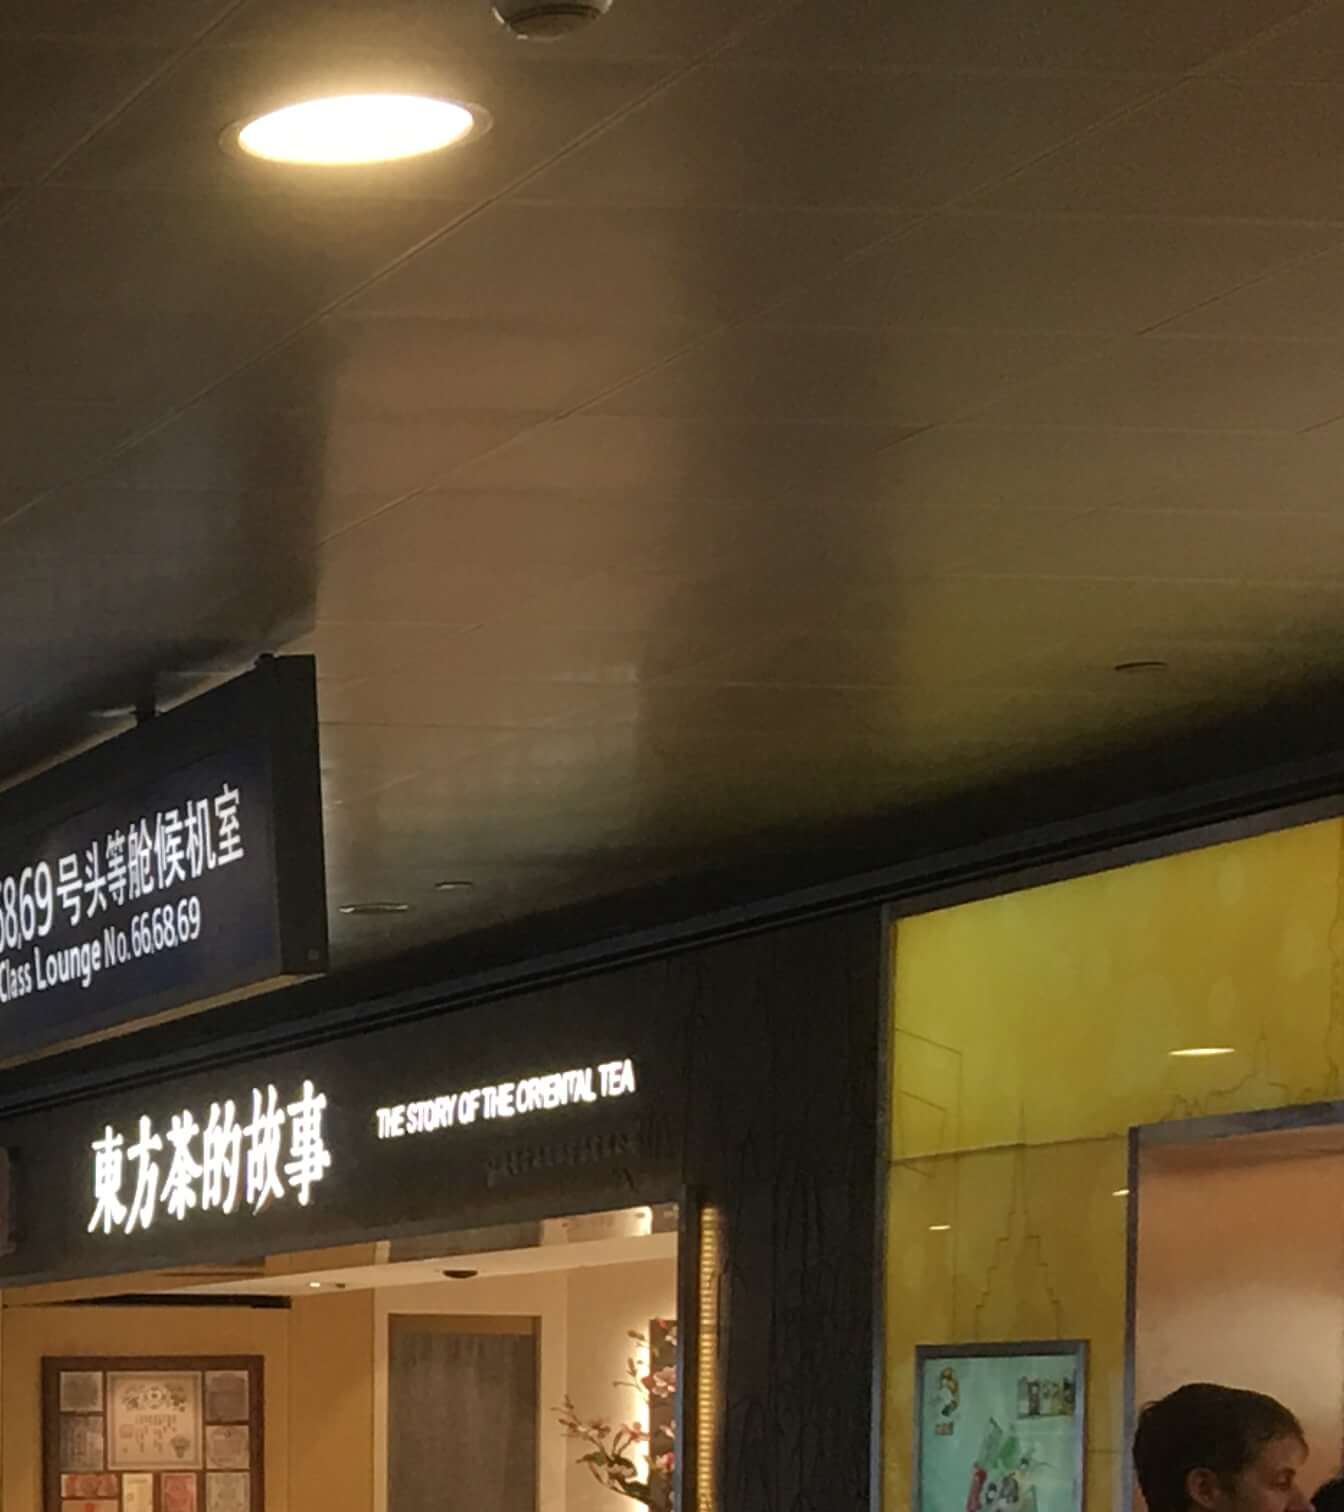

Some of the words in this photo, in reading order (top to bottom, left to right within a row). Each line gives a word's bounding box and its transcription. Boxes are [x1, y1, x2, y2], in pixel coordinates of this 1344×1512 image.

[34, 938, 101, 988] Lounge
[376, 1104, 406, 1139] THE
[406, 1094, 457, 1133] STORY
[458, 1089, 481, 1124] OF
[482, 1083, 515, 1118] THE
[516, 1067, 597, 1113] ORIENTAL
[598, 1058, 636, 1097] TEA
[87, 1079, 332, 1235] 東方茶的故事
